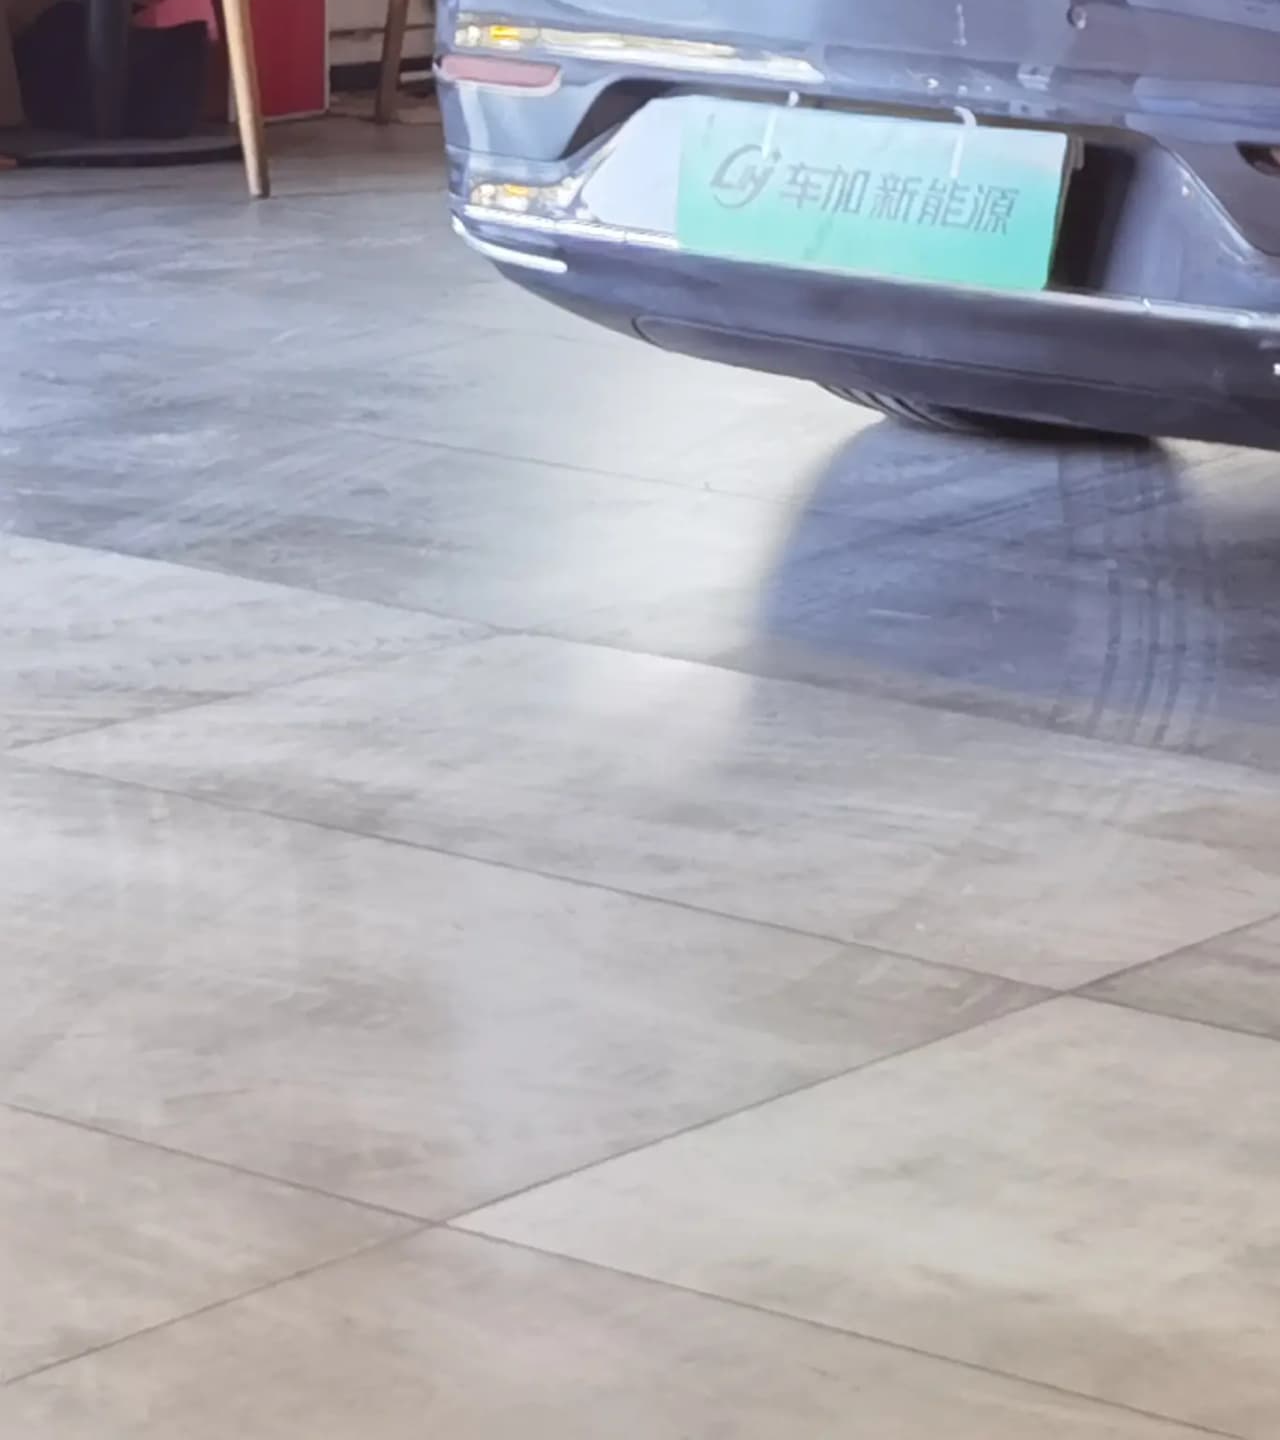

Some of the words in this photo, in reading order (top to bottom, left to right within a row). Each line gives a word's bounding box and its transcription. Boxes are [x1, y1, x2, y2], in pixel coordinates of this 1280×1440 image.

[779, 162, 1019, 235] 车加新能源
